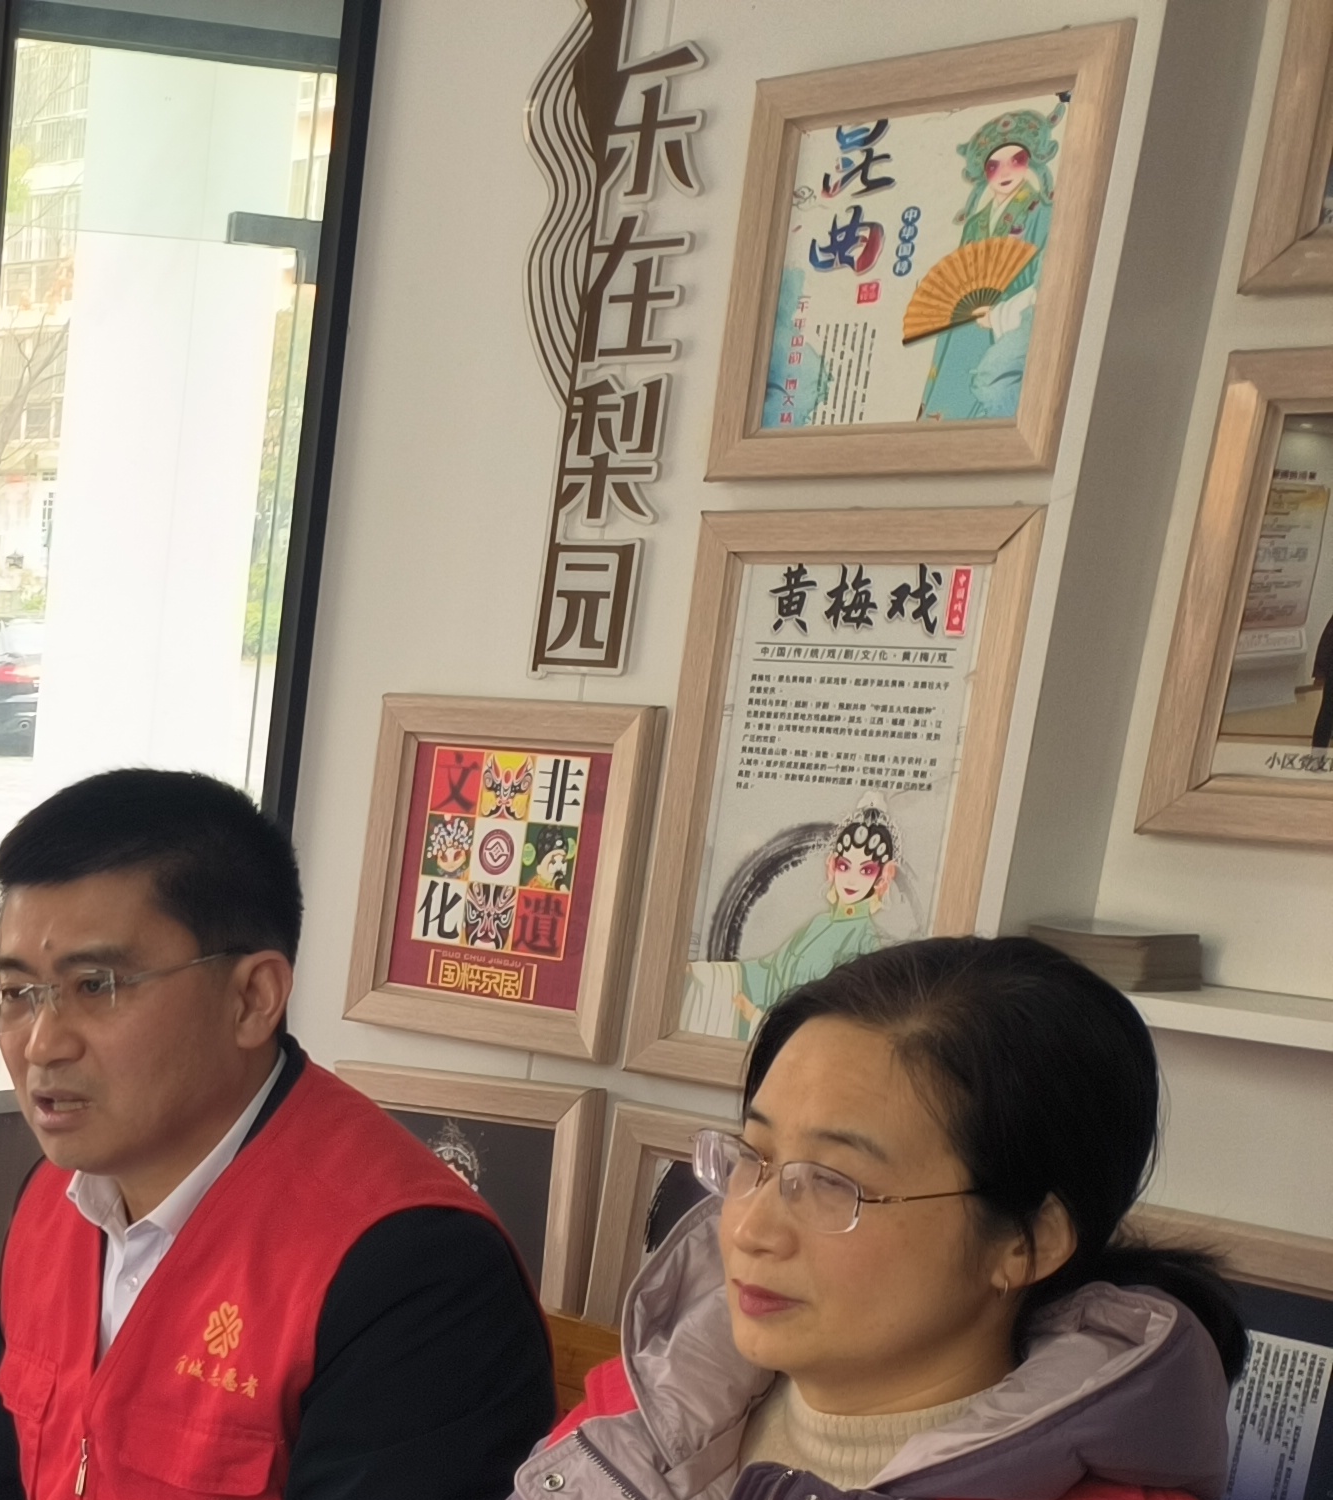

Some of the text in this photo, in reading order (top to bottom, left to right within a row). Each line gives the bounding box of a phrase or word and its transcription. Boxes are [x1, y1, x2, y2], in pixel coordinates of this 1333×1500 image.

[809, 119, 896, 275] 昆曲
[536, 42, 704, 672] 乐在梨园
[769, 562, 942, 634] 黄梅戏
[432, 751, 480, 812] 文
[534, 758, 587, 822] 非
[418, 879, 462, 939] 化
[438, 958, 524, 999] 国粹京剧
